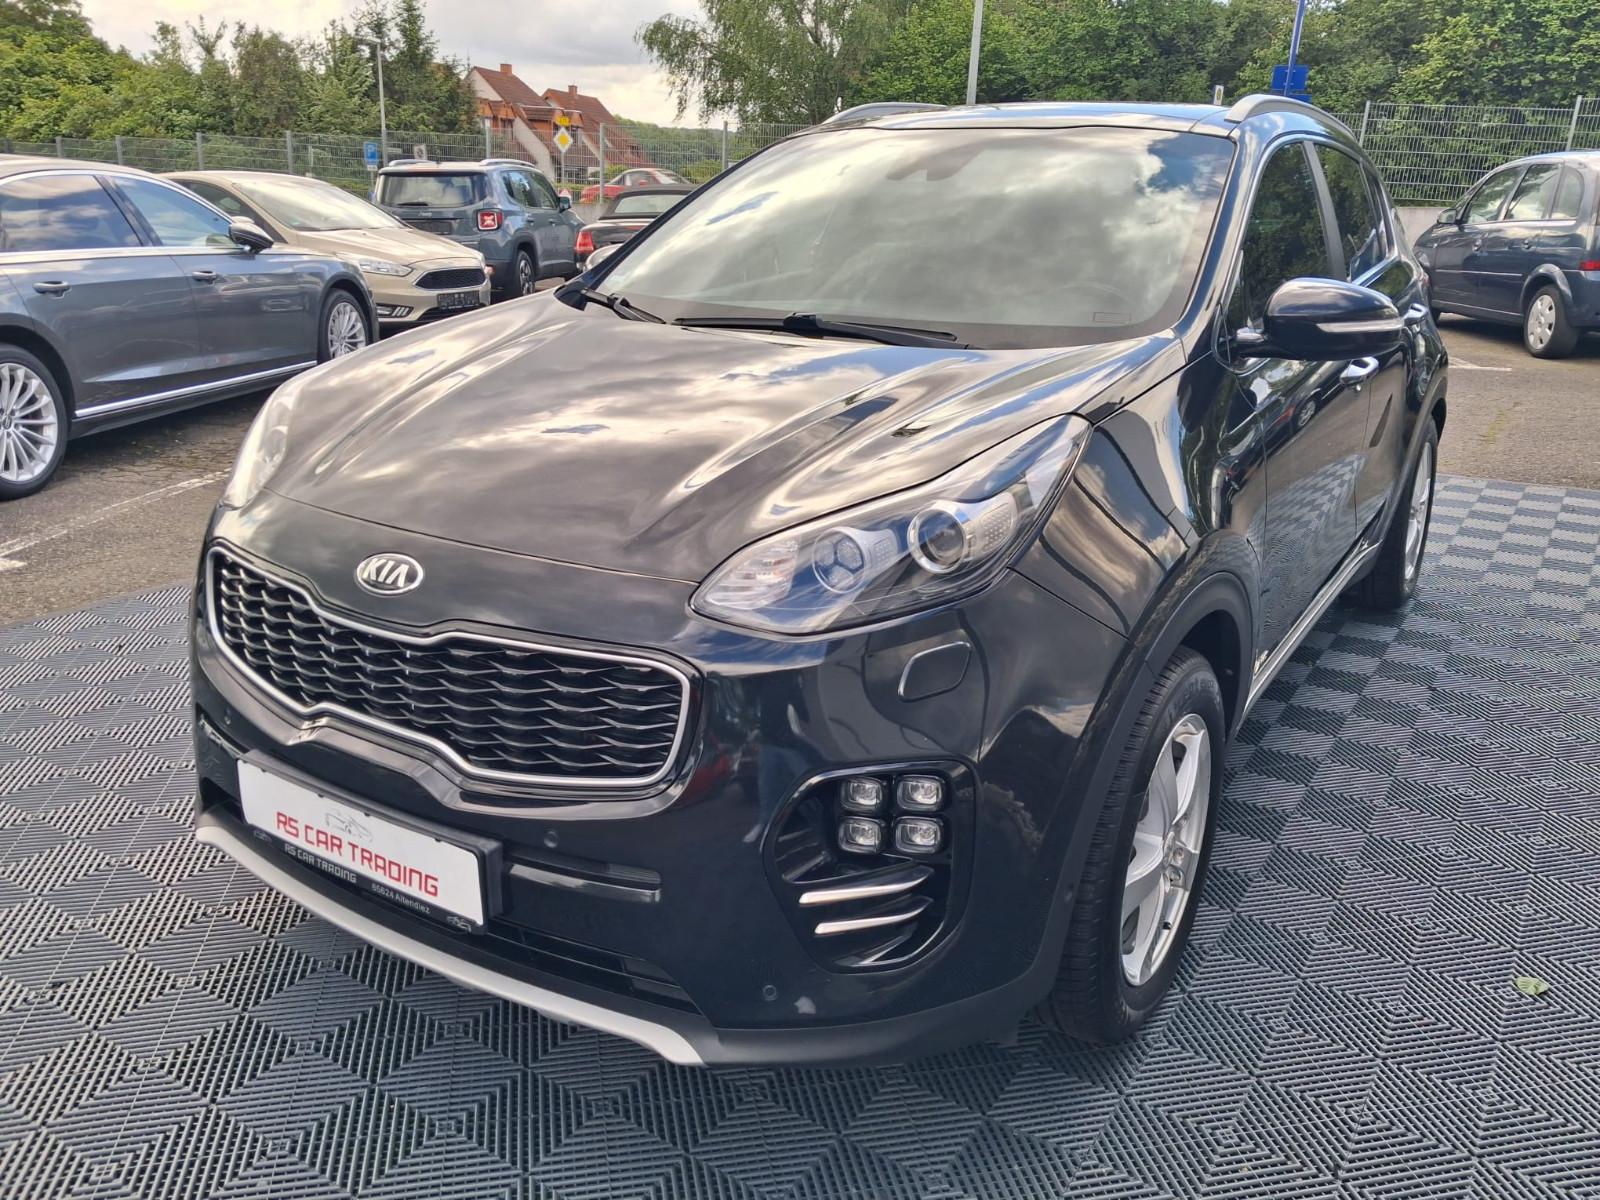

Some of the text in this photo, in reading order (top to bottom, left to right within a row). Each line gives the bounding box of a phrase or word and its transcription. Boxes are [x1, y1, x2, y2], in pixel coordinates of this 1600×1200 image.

[362, 557, 410, 588] KIA
[276, 811, 439, 897] RS CAR TRADING
[284, 842, 358, 884] RS CAR TRADING
